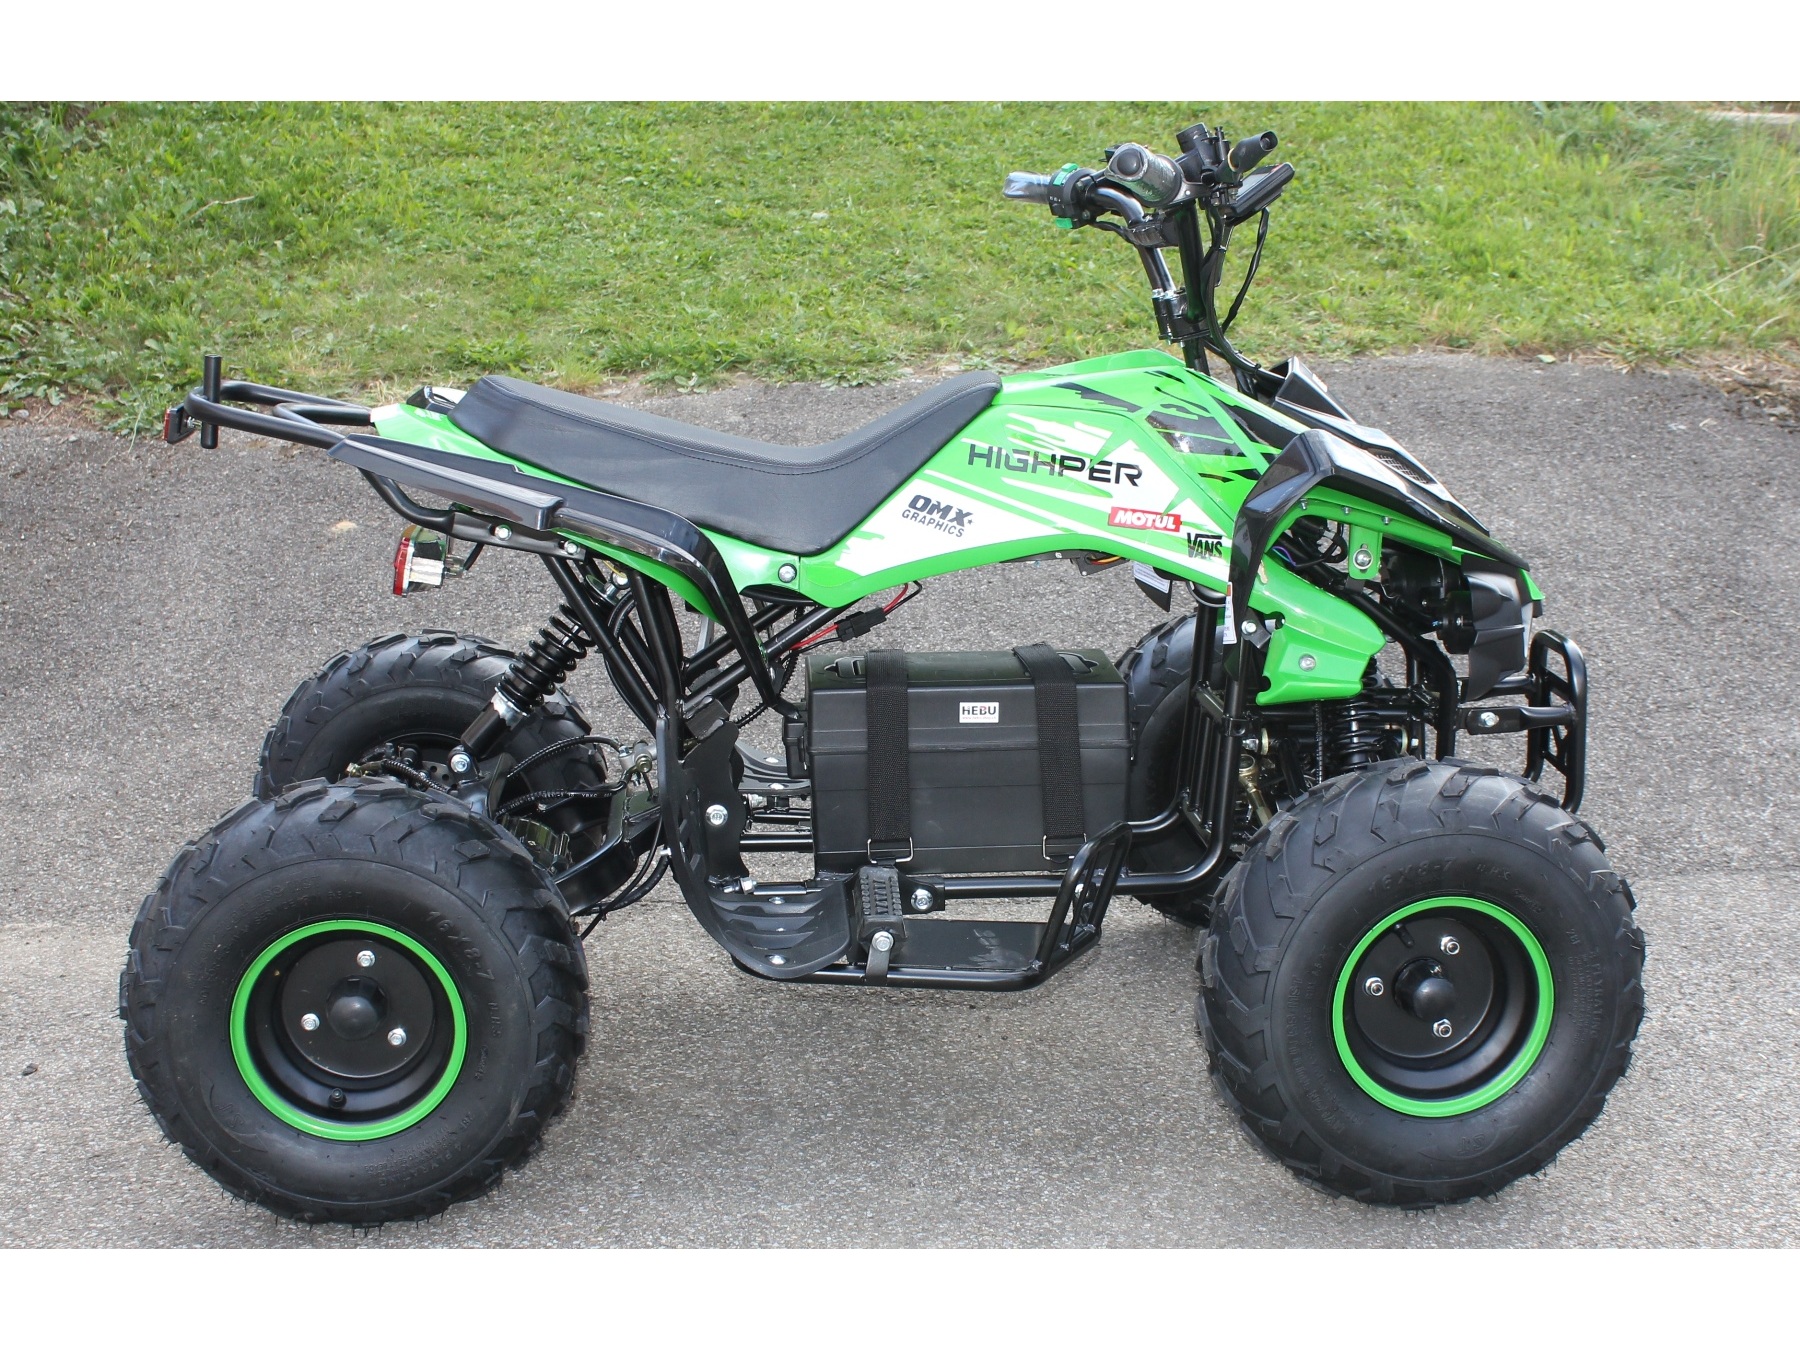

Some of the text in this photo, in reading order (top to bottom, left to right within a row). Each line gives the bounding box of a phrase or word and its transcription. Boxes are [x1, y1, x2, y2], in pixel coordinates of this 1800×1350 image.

[967, 443, 1143, 487] HIGHPER
[901, 508, 965, 538] GRAPHICS
[1113, 509, 1177, 530] MOTUL
[1186, 532, 1223, 560] VANS
[962, 705, 997, 716] HEBU
